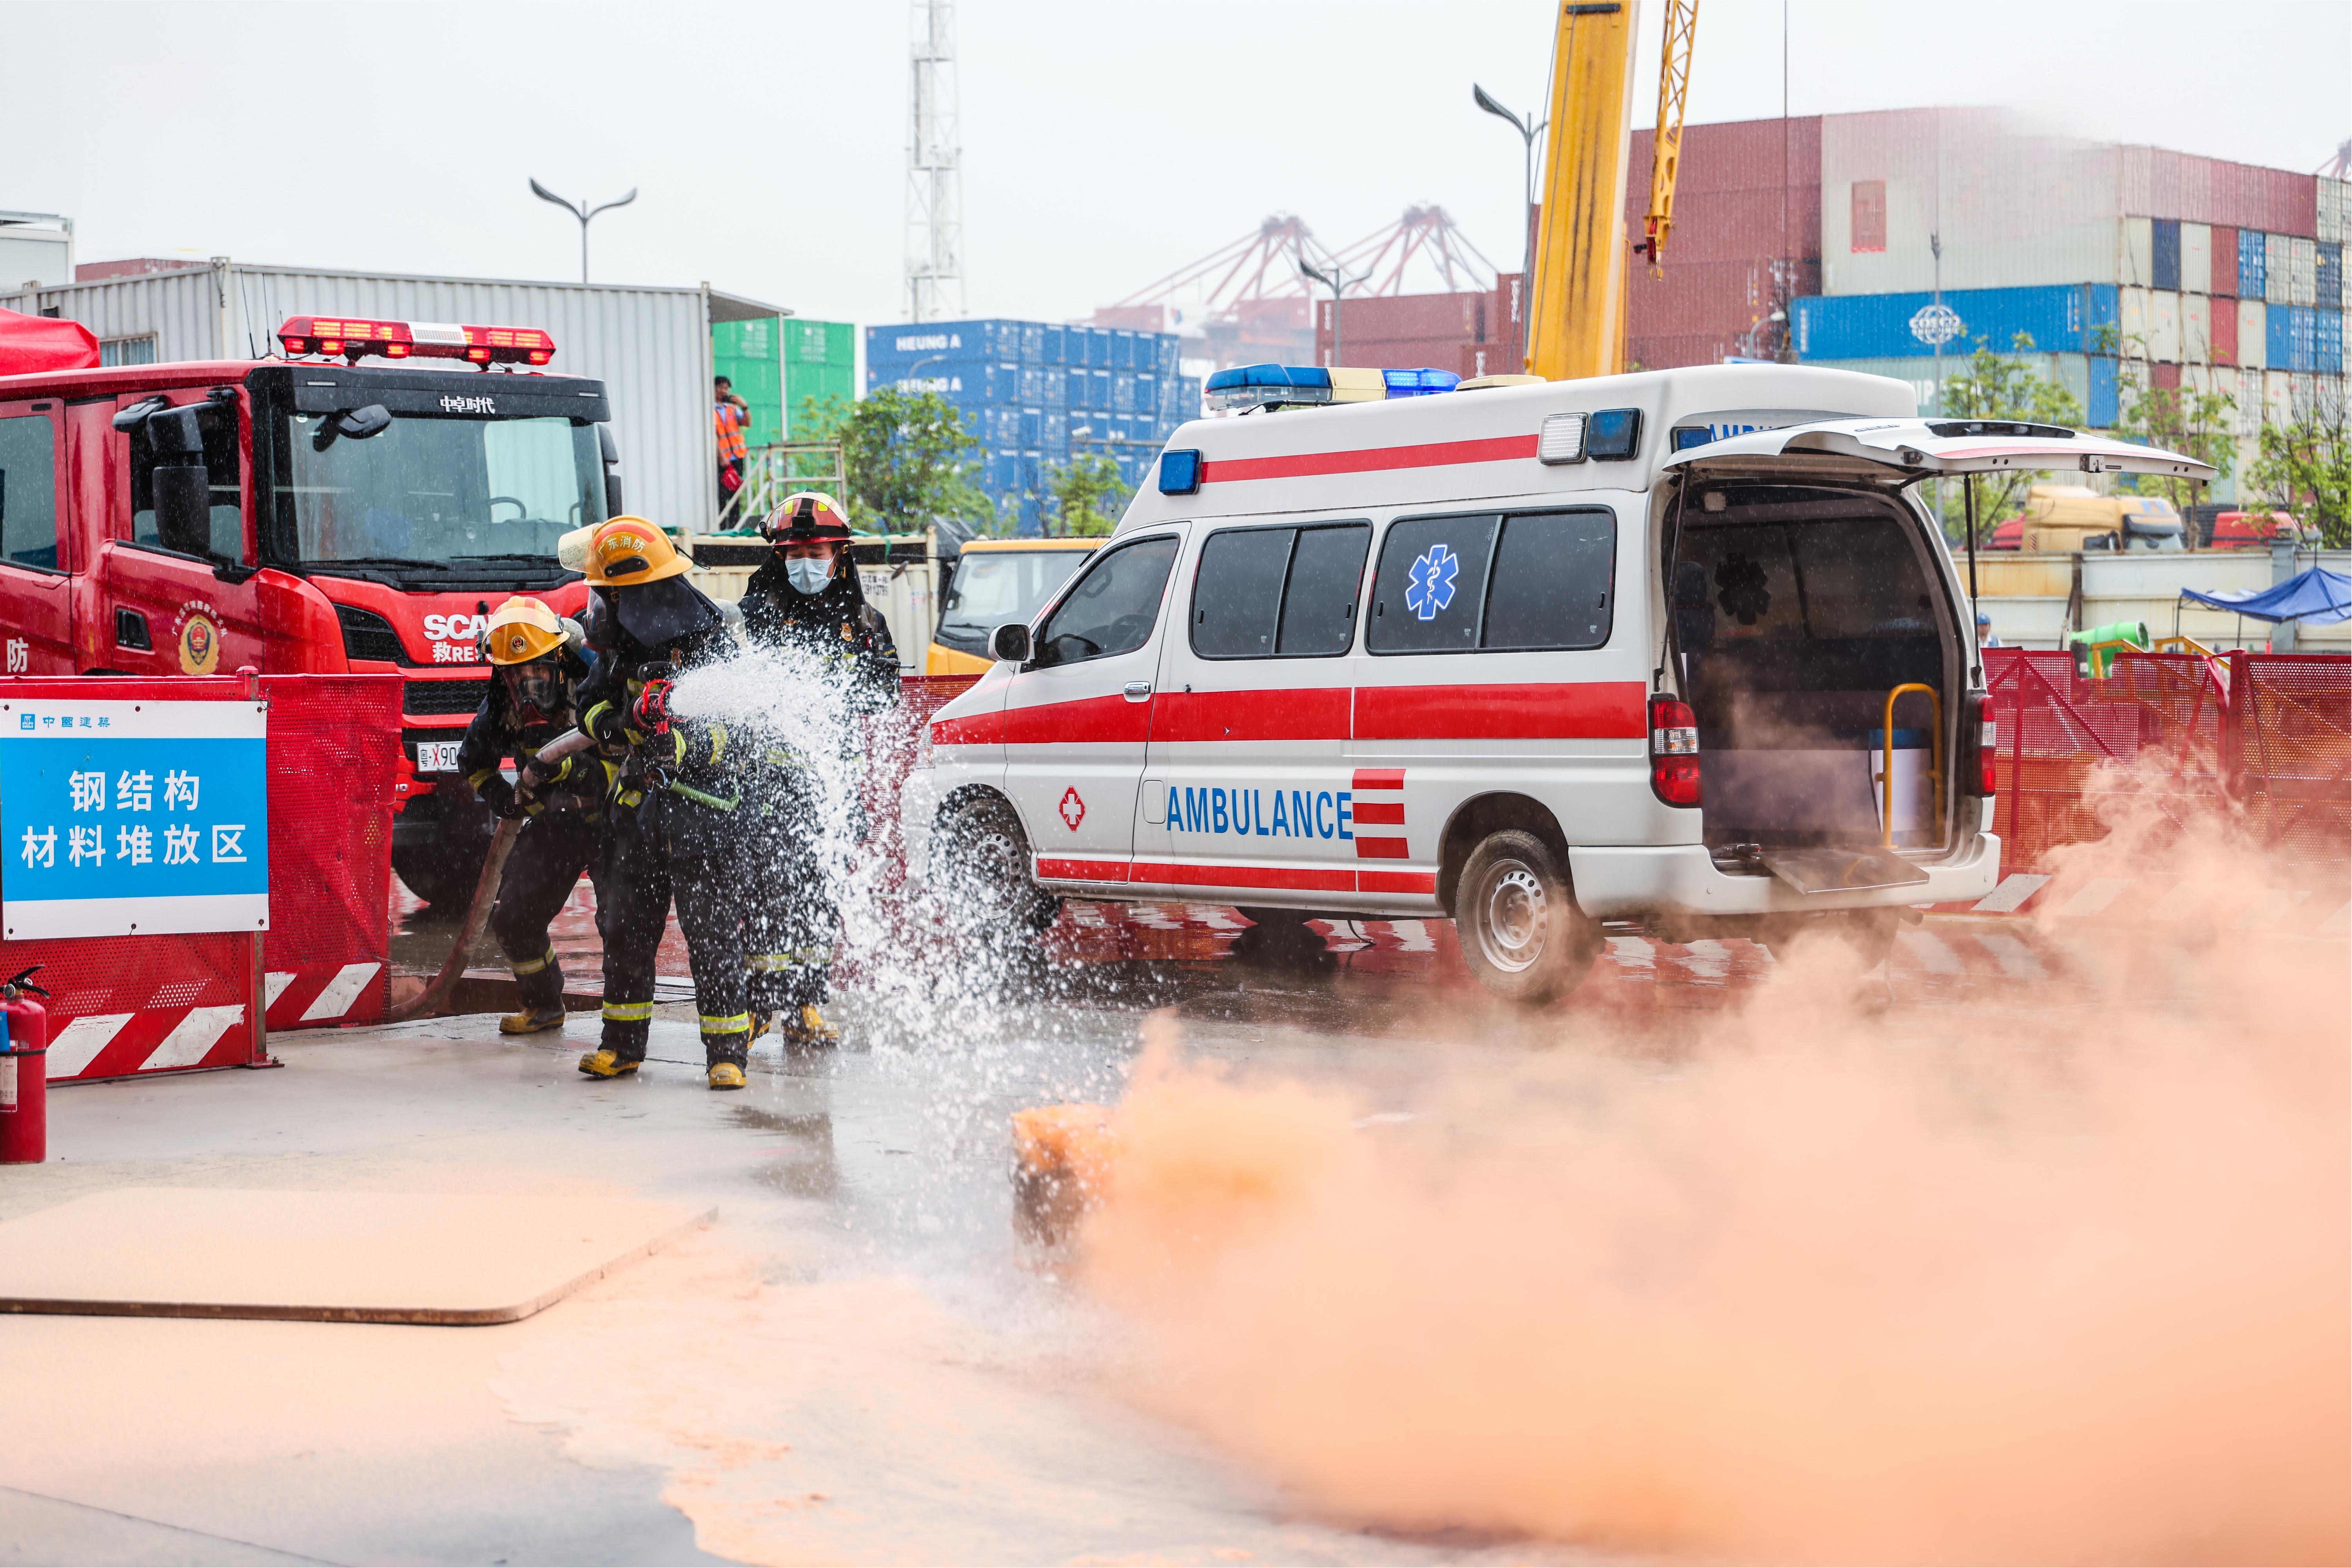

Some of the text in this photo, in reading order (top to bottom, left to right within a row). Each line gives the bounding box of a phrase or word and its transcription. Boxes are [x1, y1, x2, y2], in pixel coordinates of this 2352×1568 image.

[896, 334, 962, 351] HEUNG A
[950, 376, 962, 392] A
[439, 395, 496, 414] 中卓时代
[598, 535, 645, 558] 广东消防
[7, 637, 29, 673] 防
[68, 769, 200, 812] 钢结构
[1167, 786, 1353, 840] AMBULANCE
[21, 824, 248, 869] 材料堆放区
